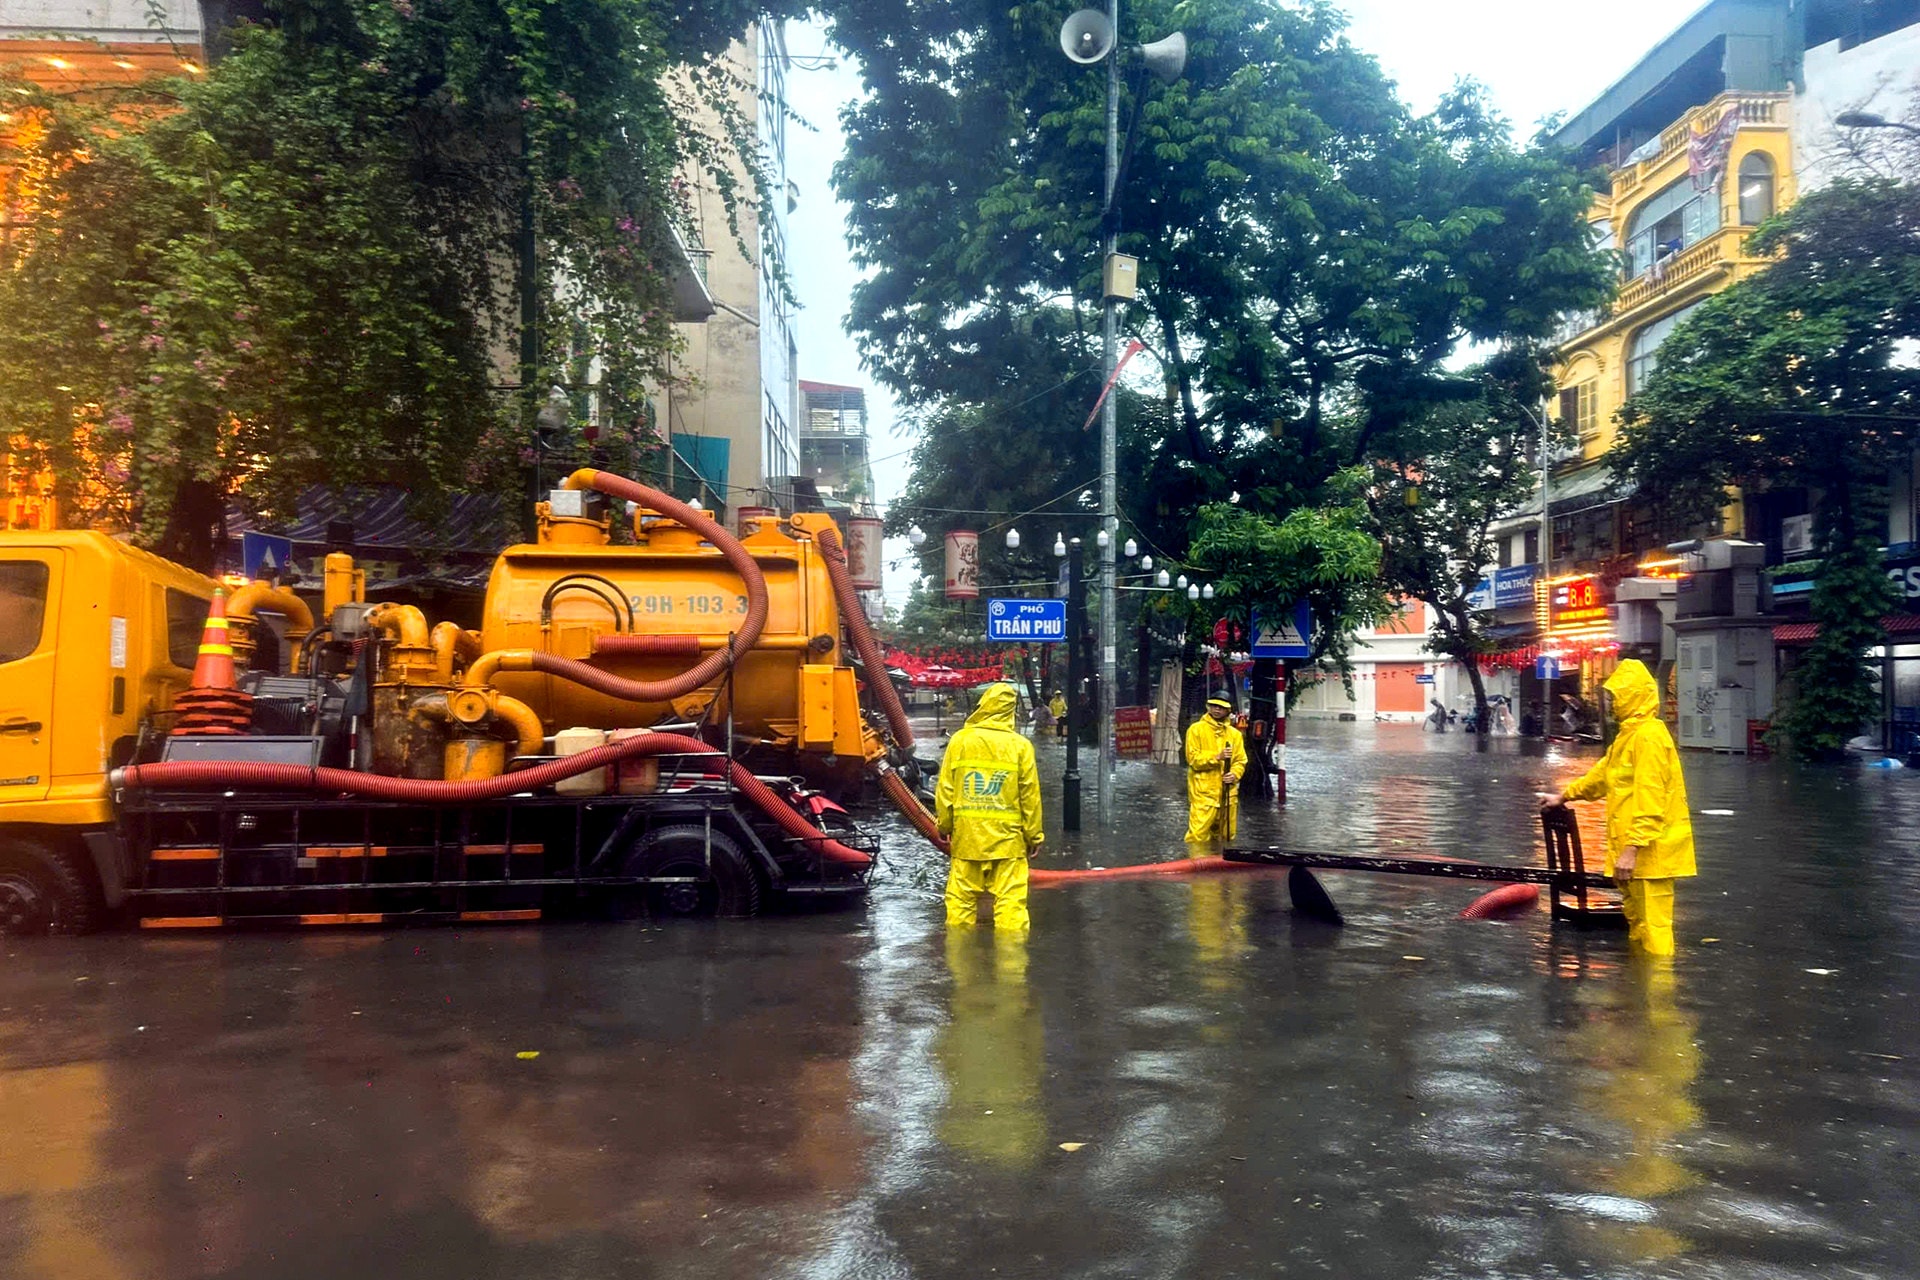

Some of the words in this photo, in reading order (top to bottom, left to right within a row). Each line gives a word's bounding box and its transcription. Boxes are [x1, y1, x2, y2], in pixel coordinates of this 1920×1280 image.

[630, 595, 749, 614] 29H-193.3
[1020, 603, 1044, 613] PHỐ
[994, 615, 1030, 634] TRẦN
[1034, 617, 1061, 634] PHÚ
